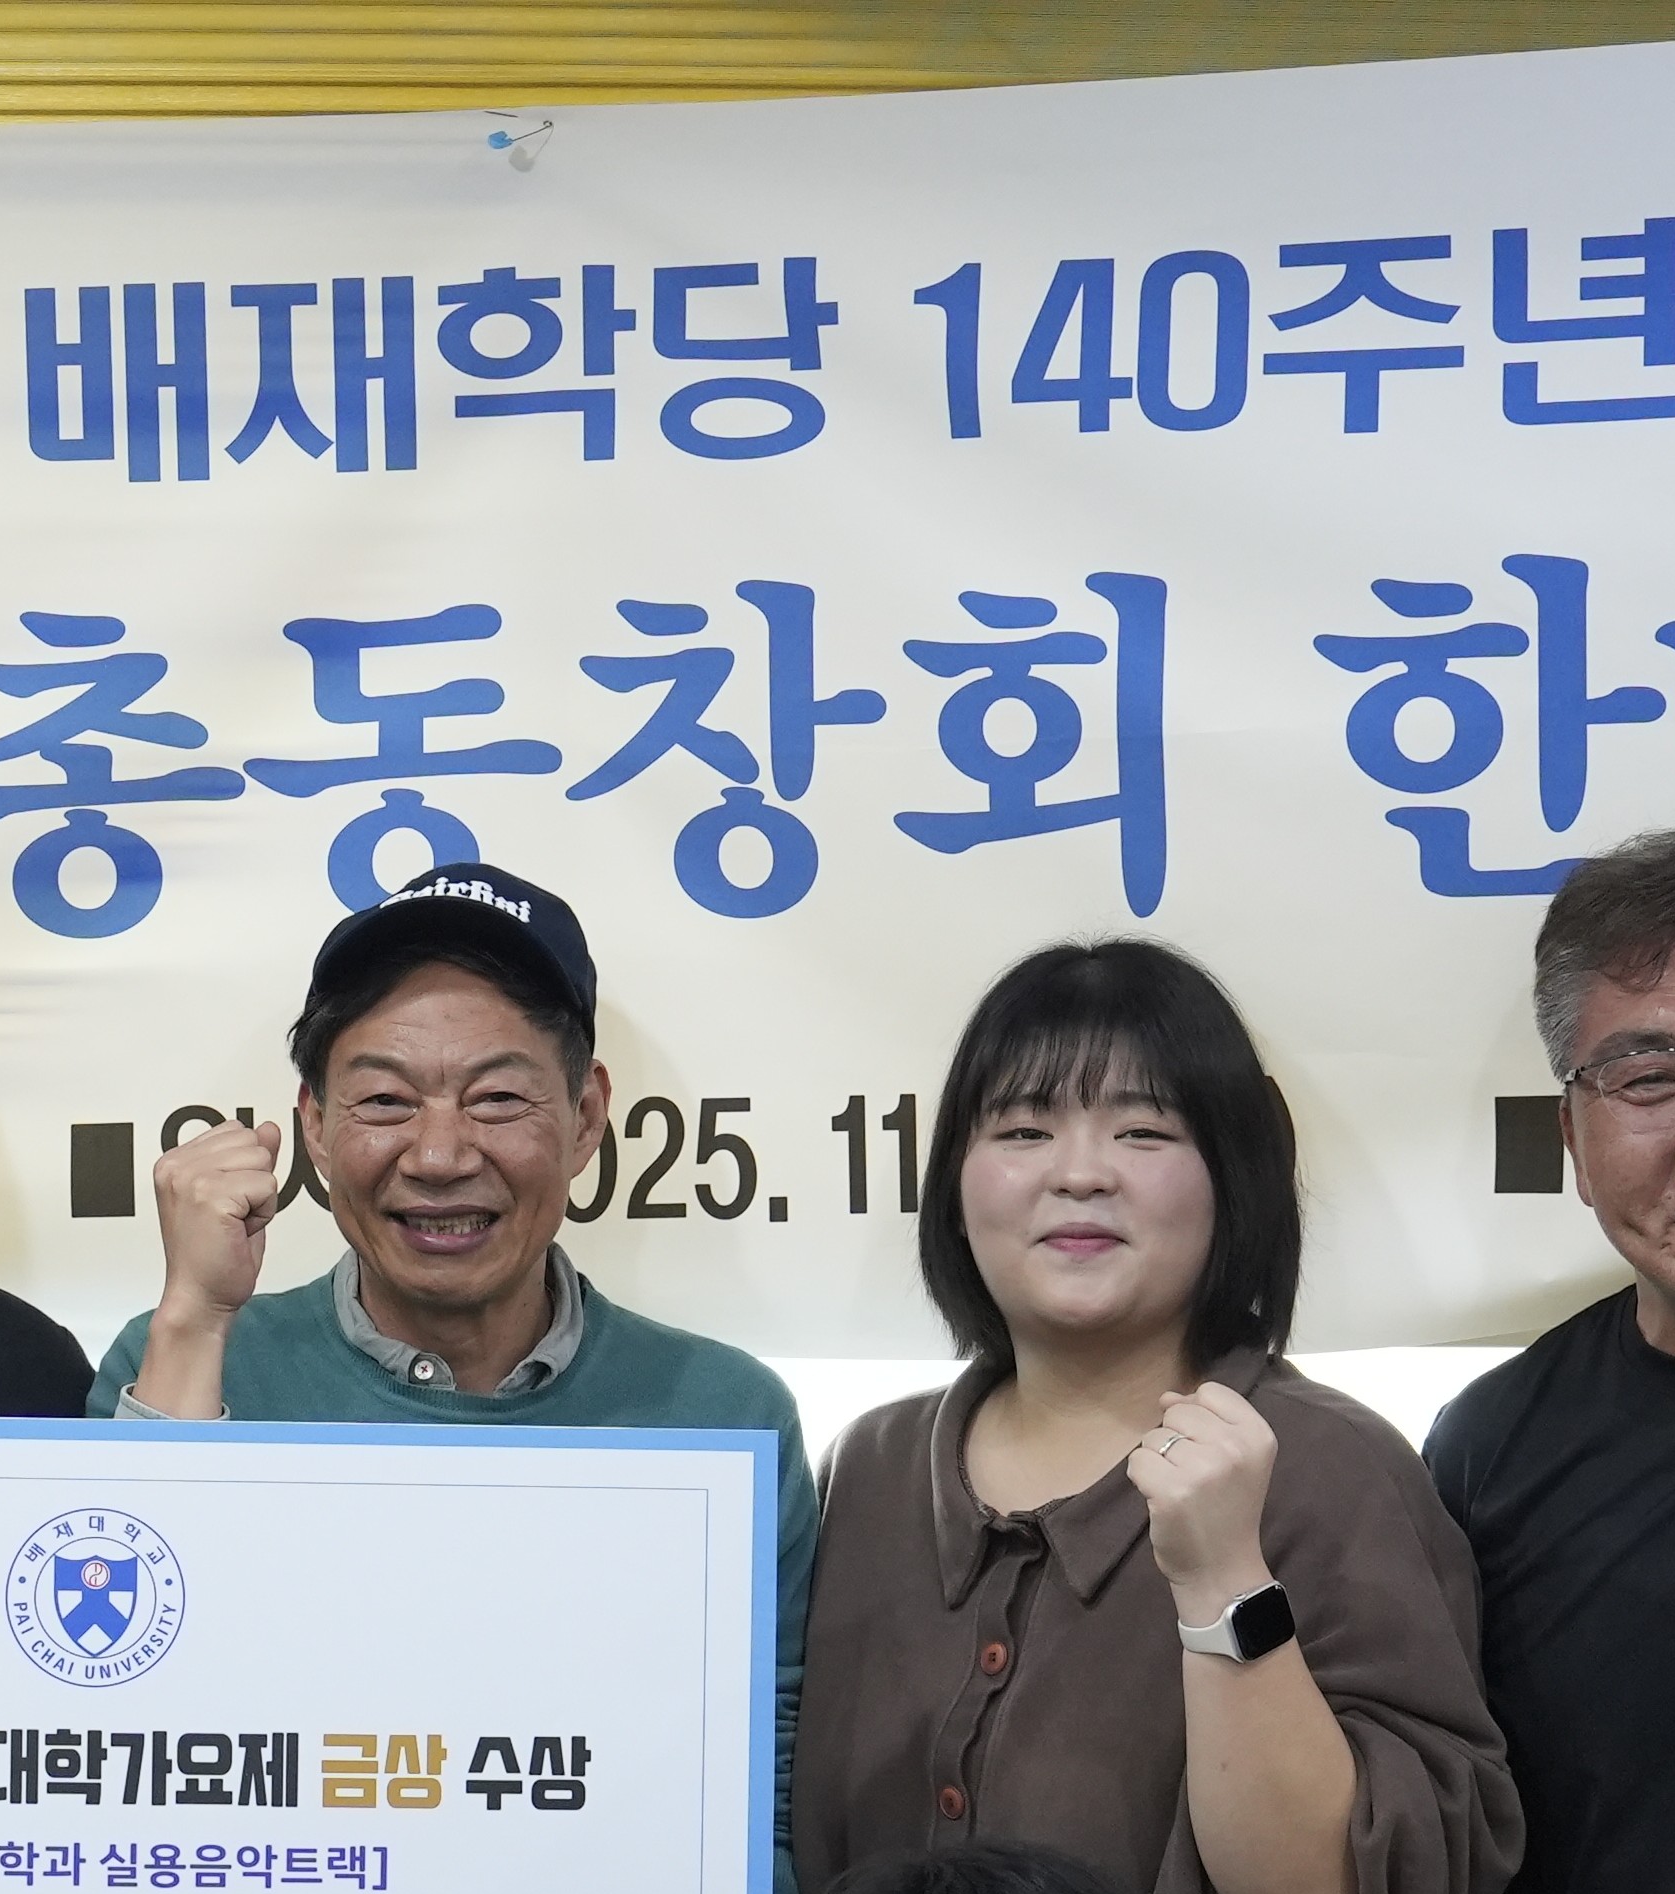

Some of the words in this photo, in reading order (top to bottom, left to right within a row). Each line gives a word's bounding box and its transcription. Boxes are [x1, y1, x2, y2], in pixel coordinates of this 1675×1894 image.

[24, 256, 840, 482] 배재학당
[13, 1602, 34, 1635] PAI
[31, 1640, 74, 1676] CHAI
[84, 1603, 177, 1680] UNIVERSITY
[322, 1733, 448, 1809] 금상
[464, 1735, 592, 1812] 수상
[98, 1841, 389, 1892] 실용음악트랙]
